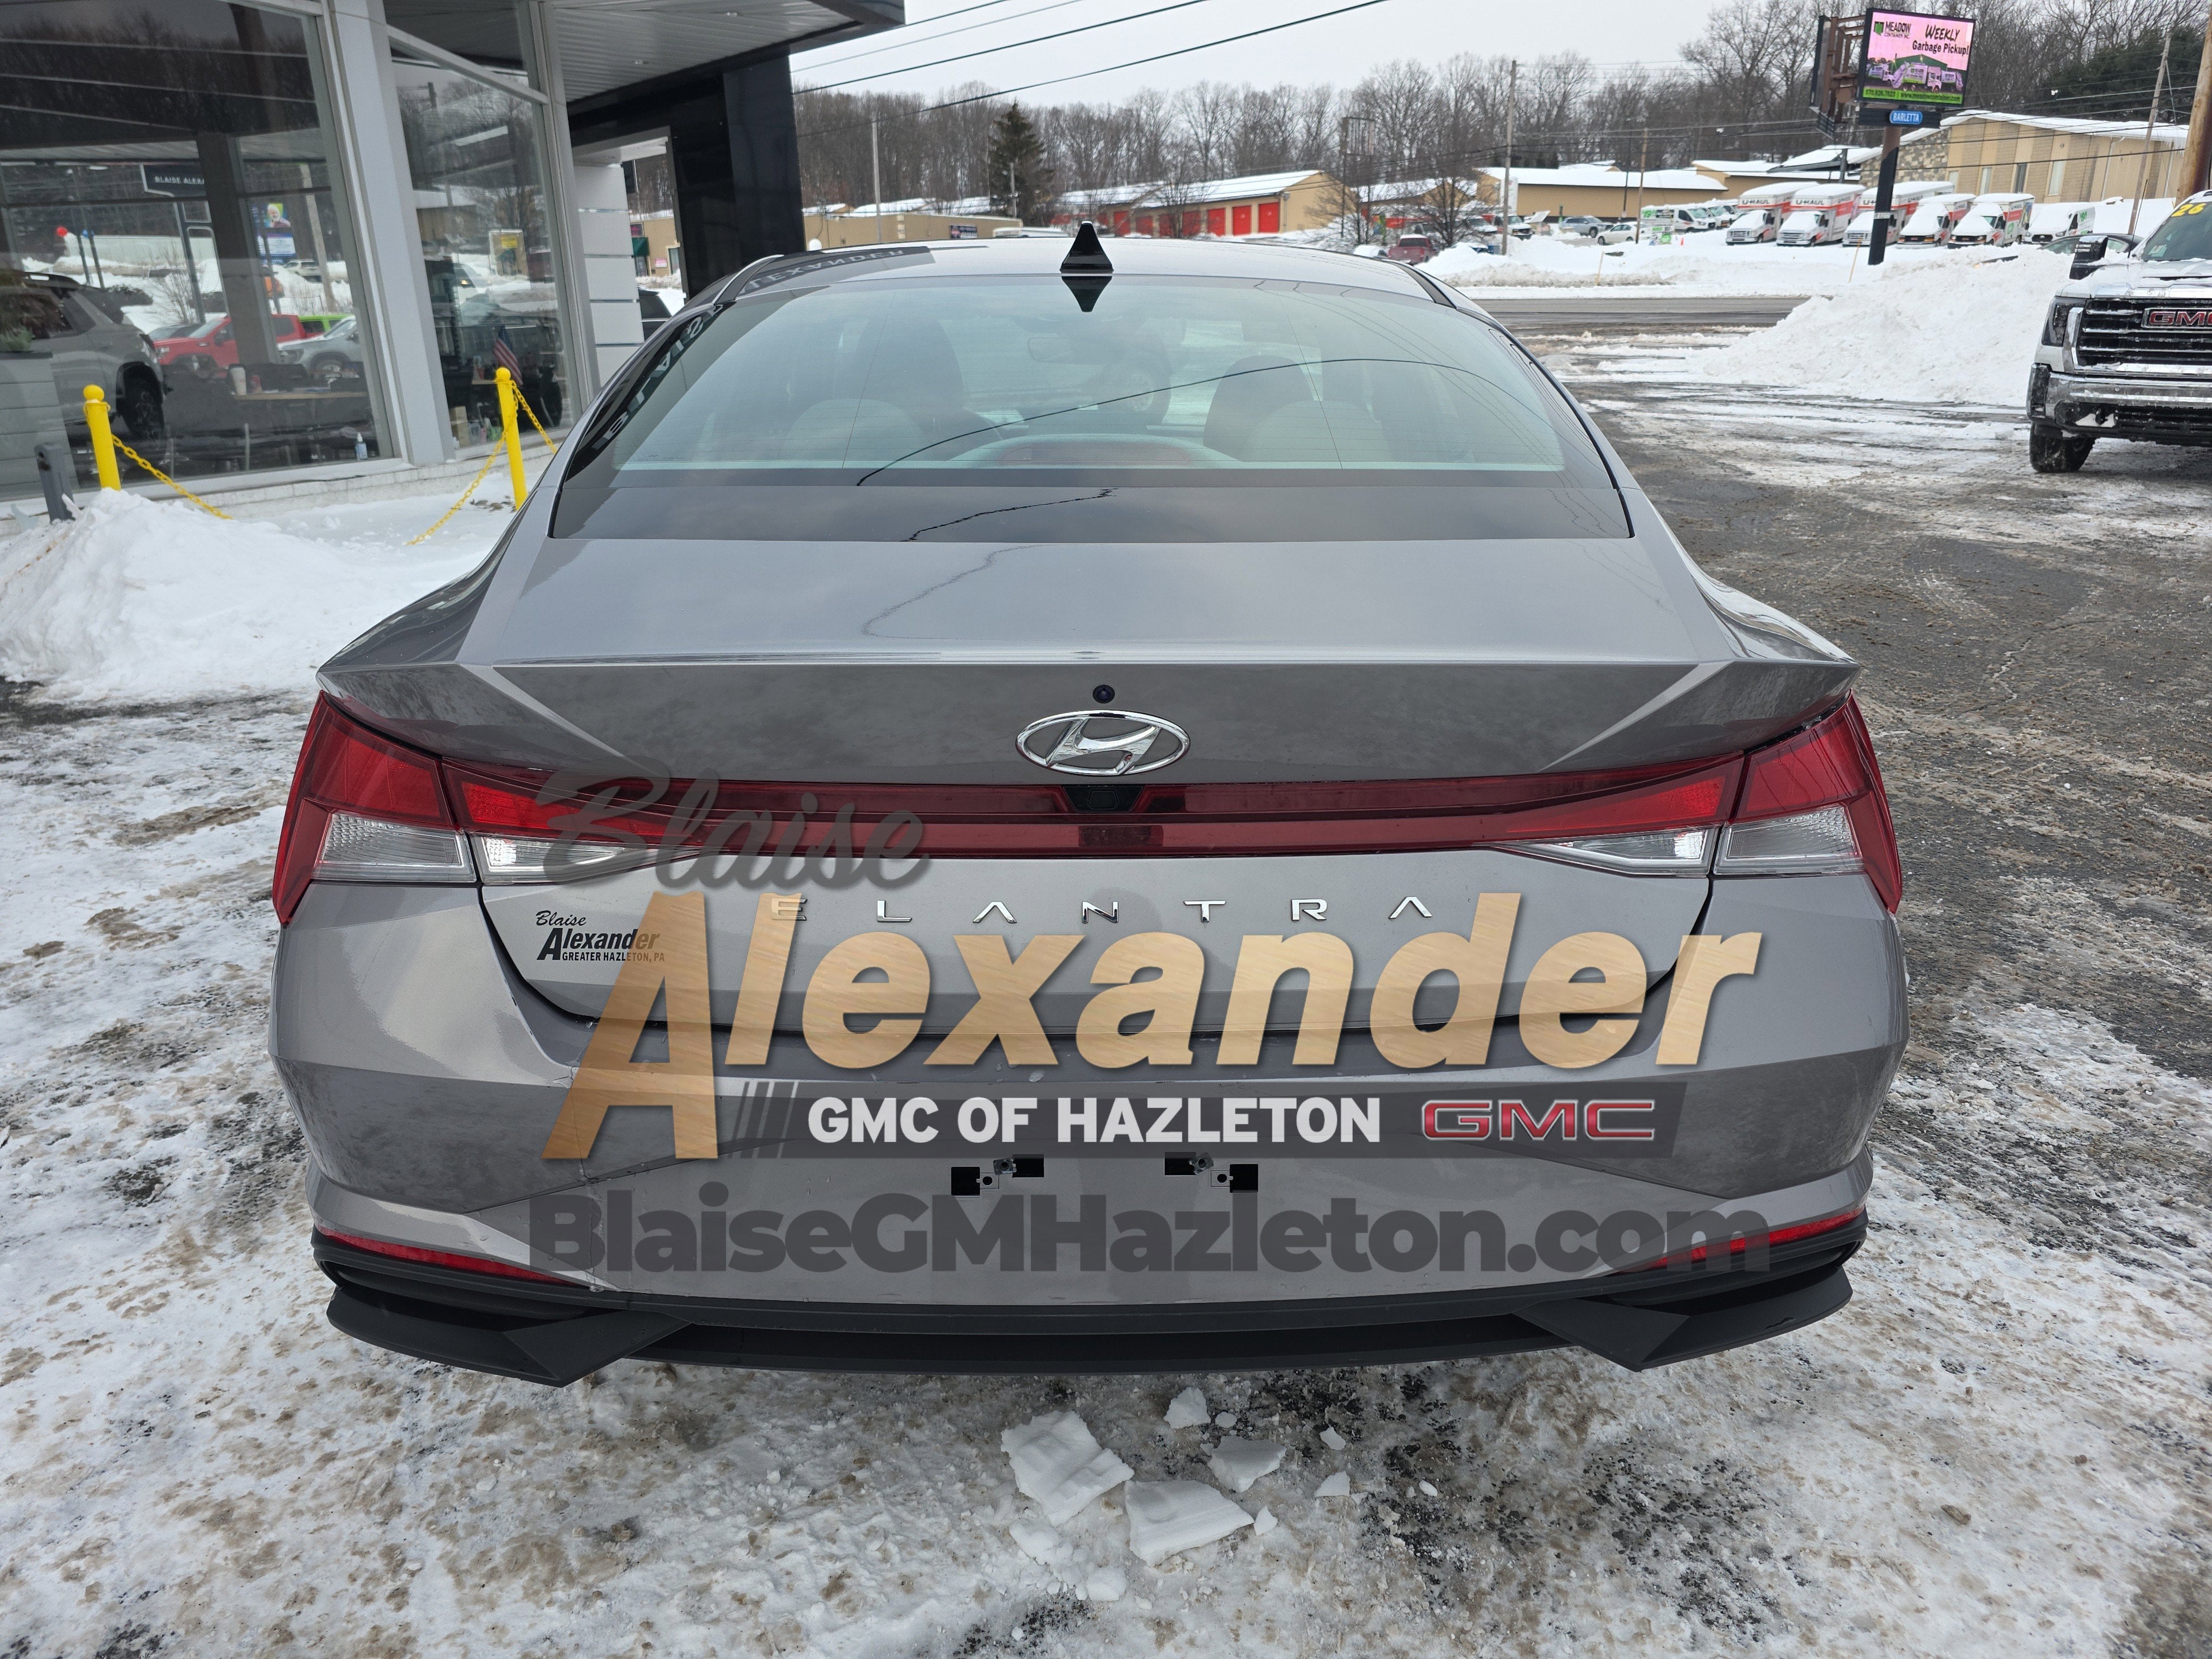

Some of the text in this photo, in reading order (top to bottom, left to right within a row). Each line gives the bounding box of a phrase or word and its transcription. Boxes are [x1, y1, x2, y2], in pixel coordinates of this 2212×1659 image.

[1885, 21, 1912, 34] MEADOW
[1925, 24, 1960, 42] WEEKLY
[1912, 40, 1969, 56] Garbage Pickup!
[1893, 112, 1920, 123] BARLETTA
[2171, 203, 2207, 217] 26
[2149, 311, 2212, 326] GM
[770, 896, 1433, 924] ELANTRA
[536, 910, 587, 926] Blaise
[536, 928, 660, 961] Alexander
[562, 951, 665, 963] GREATER HAZLETON, PA
